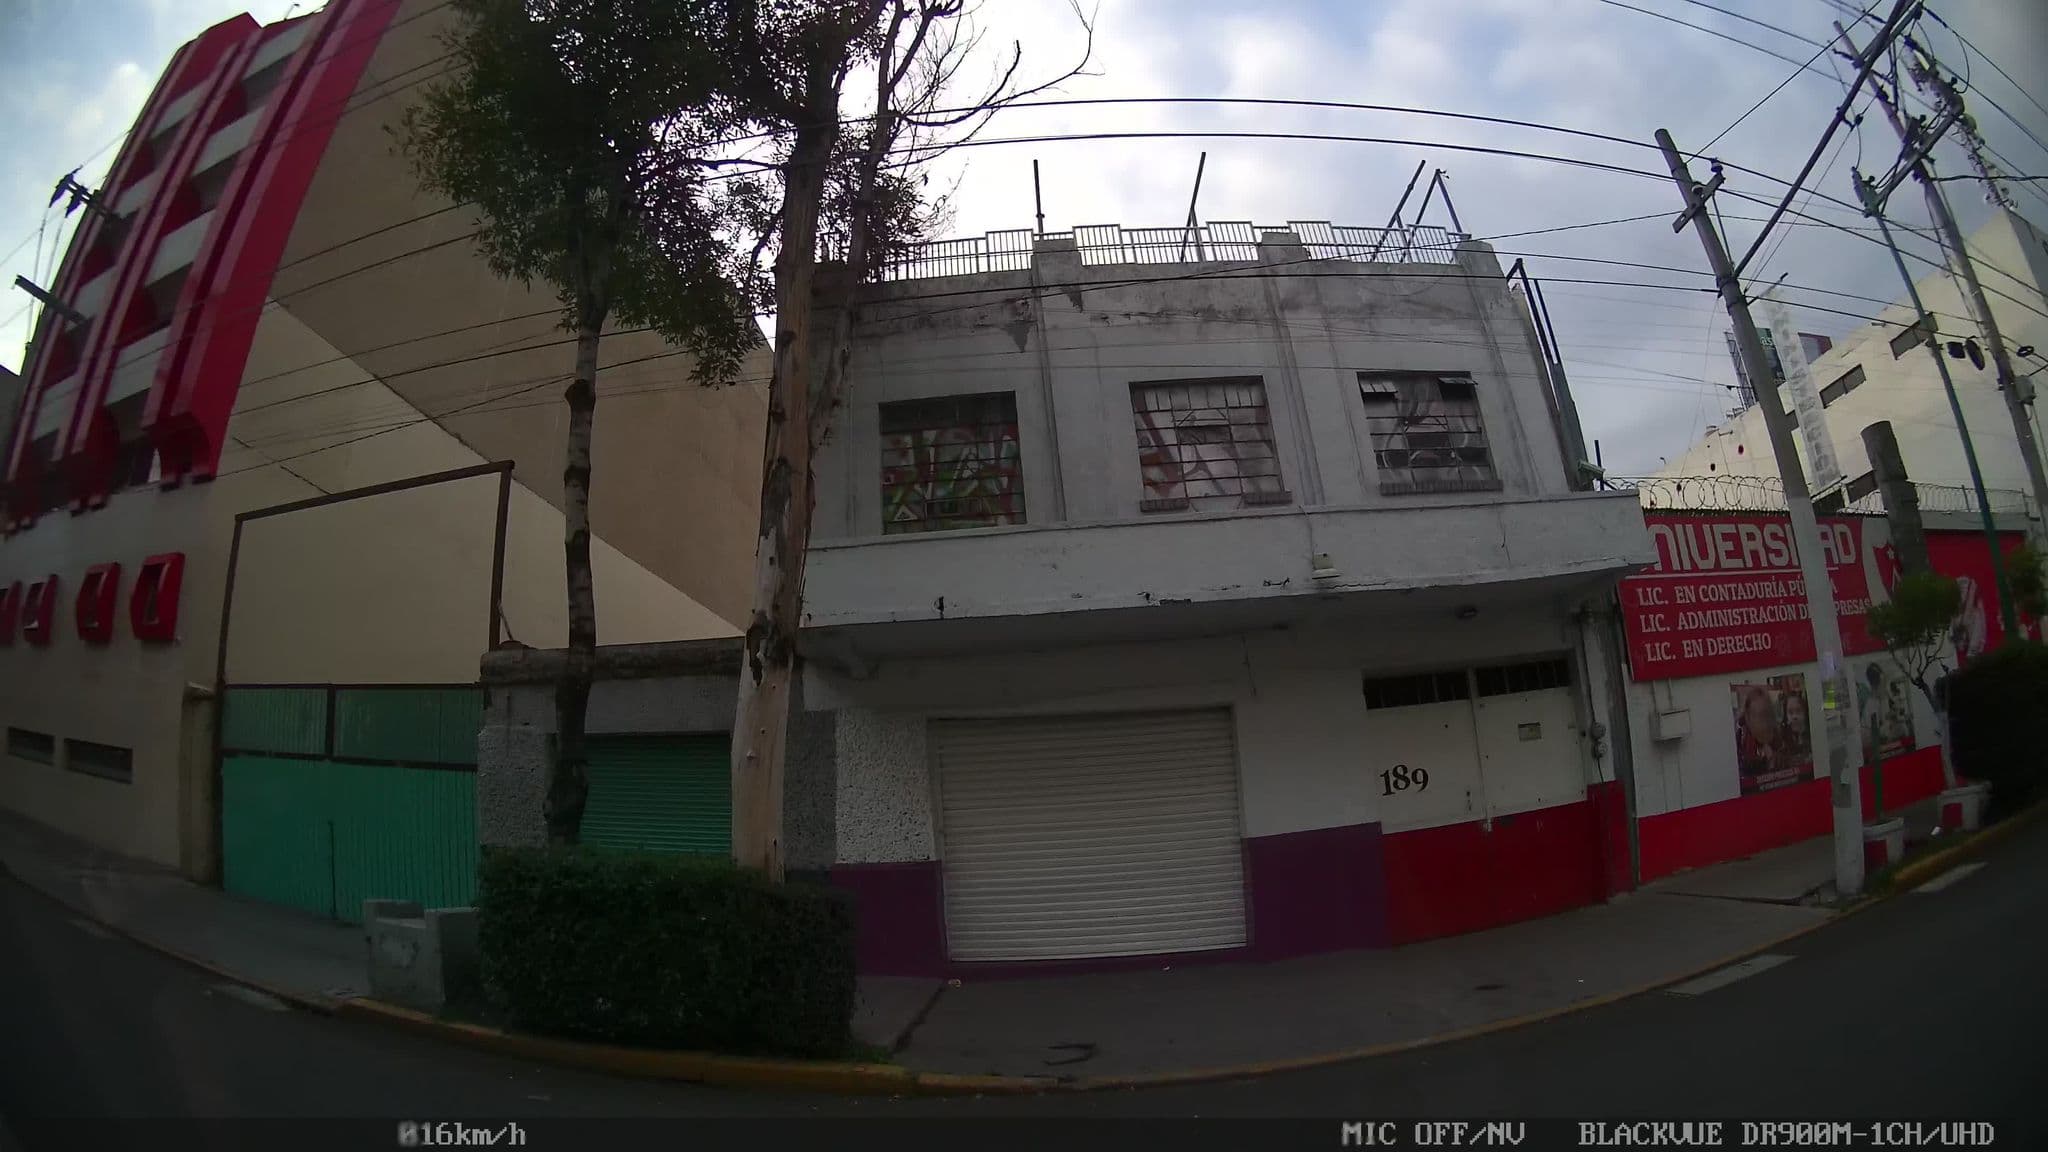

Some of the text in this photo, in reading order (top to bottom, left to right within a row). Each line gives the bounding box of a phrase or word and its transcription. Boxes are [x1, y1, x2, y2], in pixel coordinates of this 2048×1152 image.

[1648, 523, 1856, 571] NIVERSIAD
[1637, 586, 1668, 606] LIC.
[1676, 585, 1697, 605] EN
[1699, 576, 1787, 602] CONTADURÍA
[1640, 613, 1671, 632] LIC.
[1677, 600, 1798, 631] ADMINISTRACIÓN
[1646, 641, 1676, 661] LIC.
[1684, 638, 1704, 657] EN
[1707, 633, 1772, 656] DERECHO
[1379, 764, 1429, 796] 189
